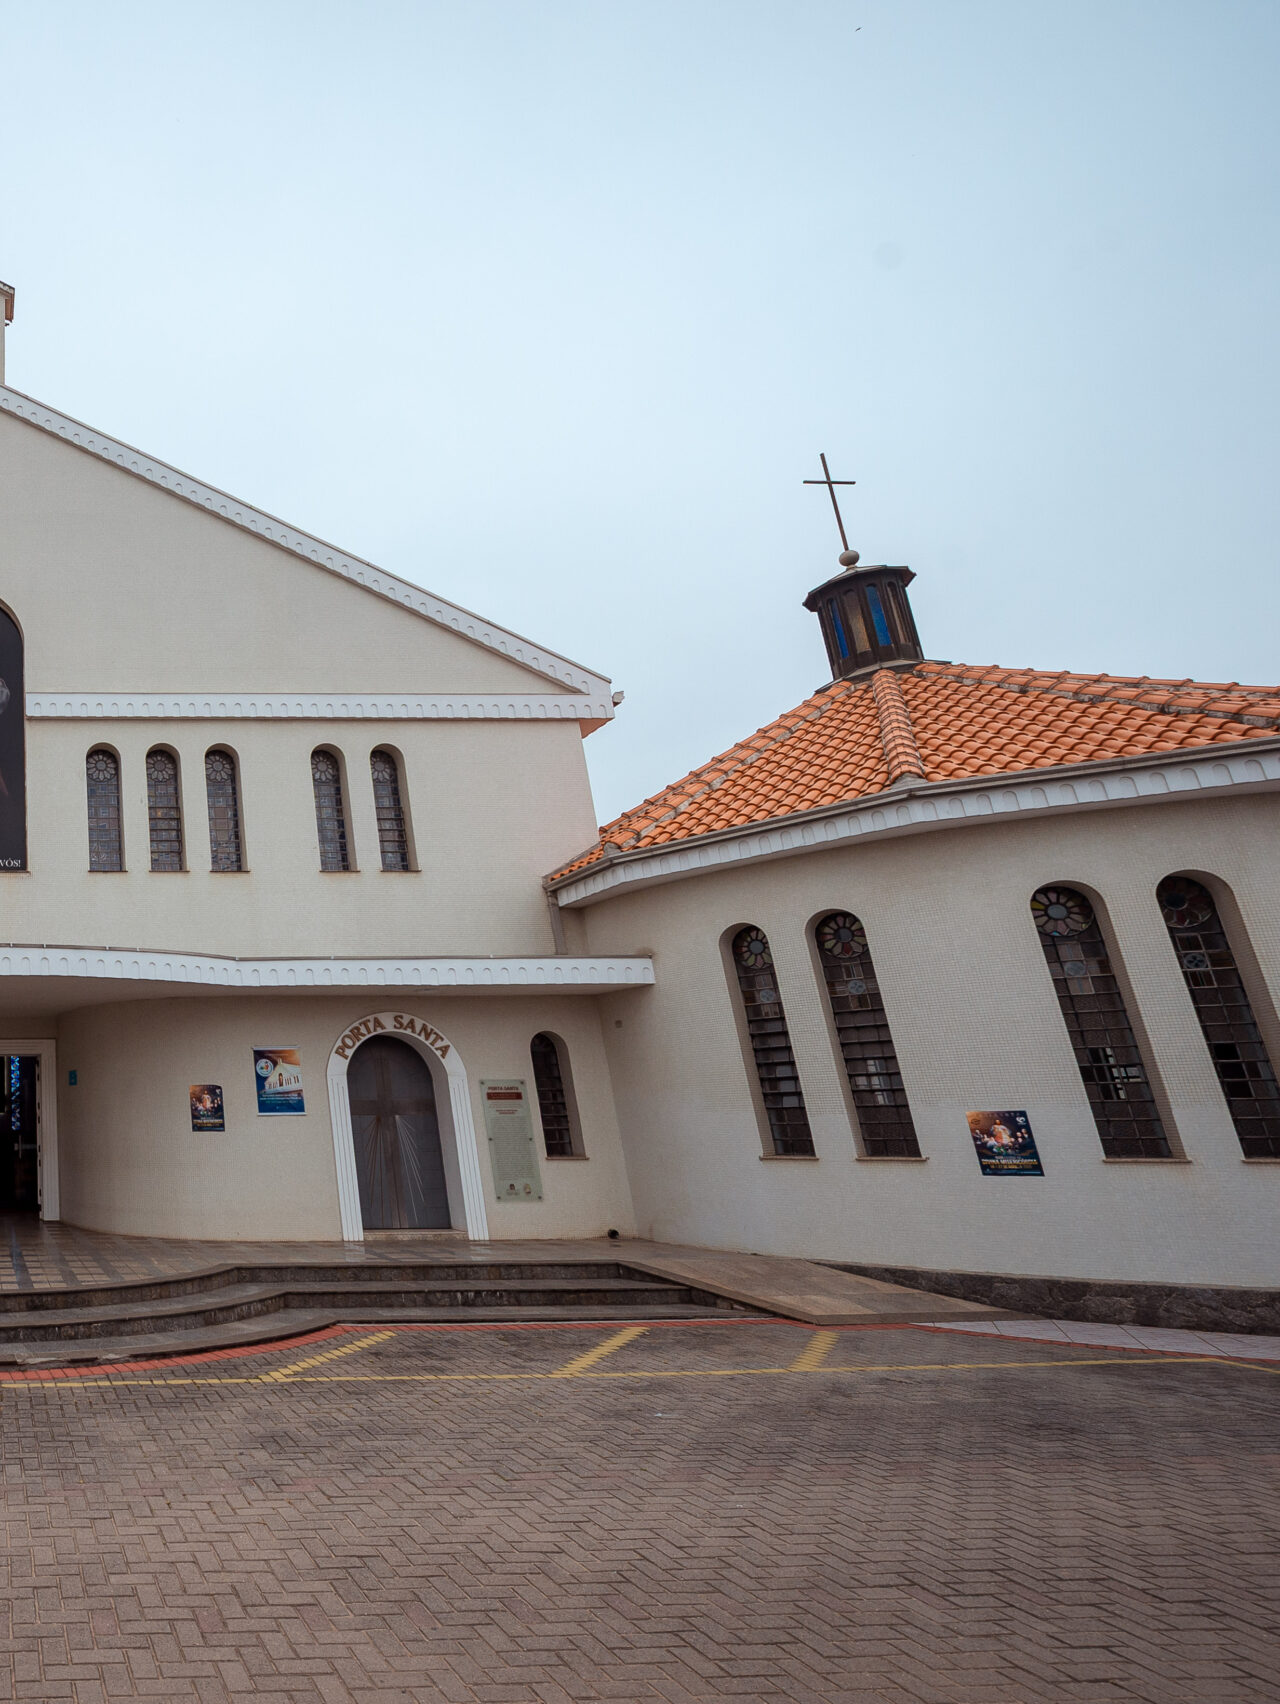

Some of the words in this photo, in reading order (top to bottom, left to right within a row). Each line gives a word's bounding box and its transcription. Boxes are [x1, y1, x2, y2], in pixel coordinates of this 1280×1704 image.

[0, 858, 21, 868] VÓS!
[335, 1016, 386, 1060] PORTA
[393, 1014, 451, 1059] SANTA
